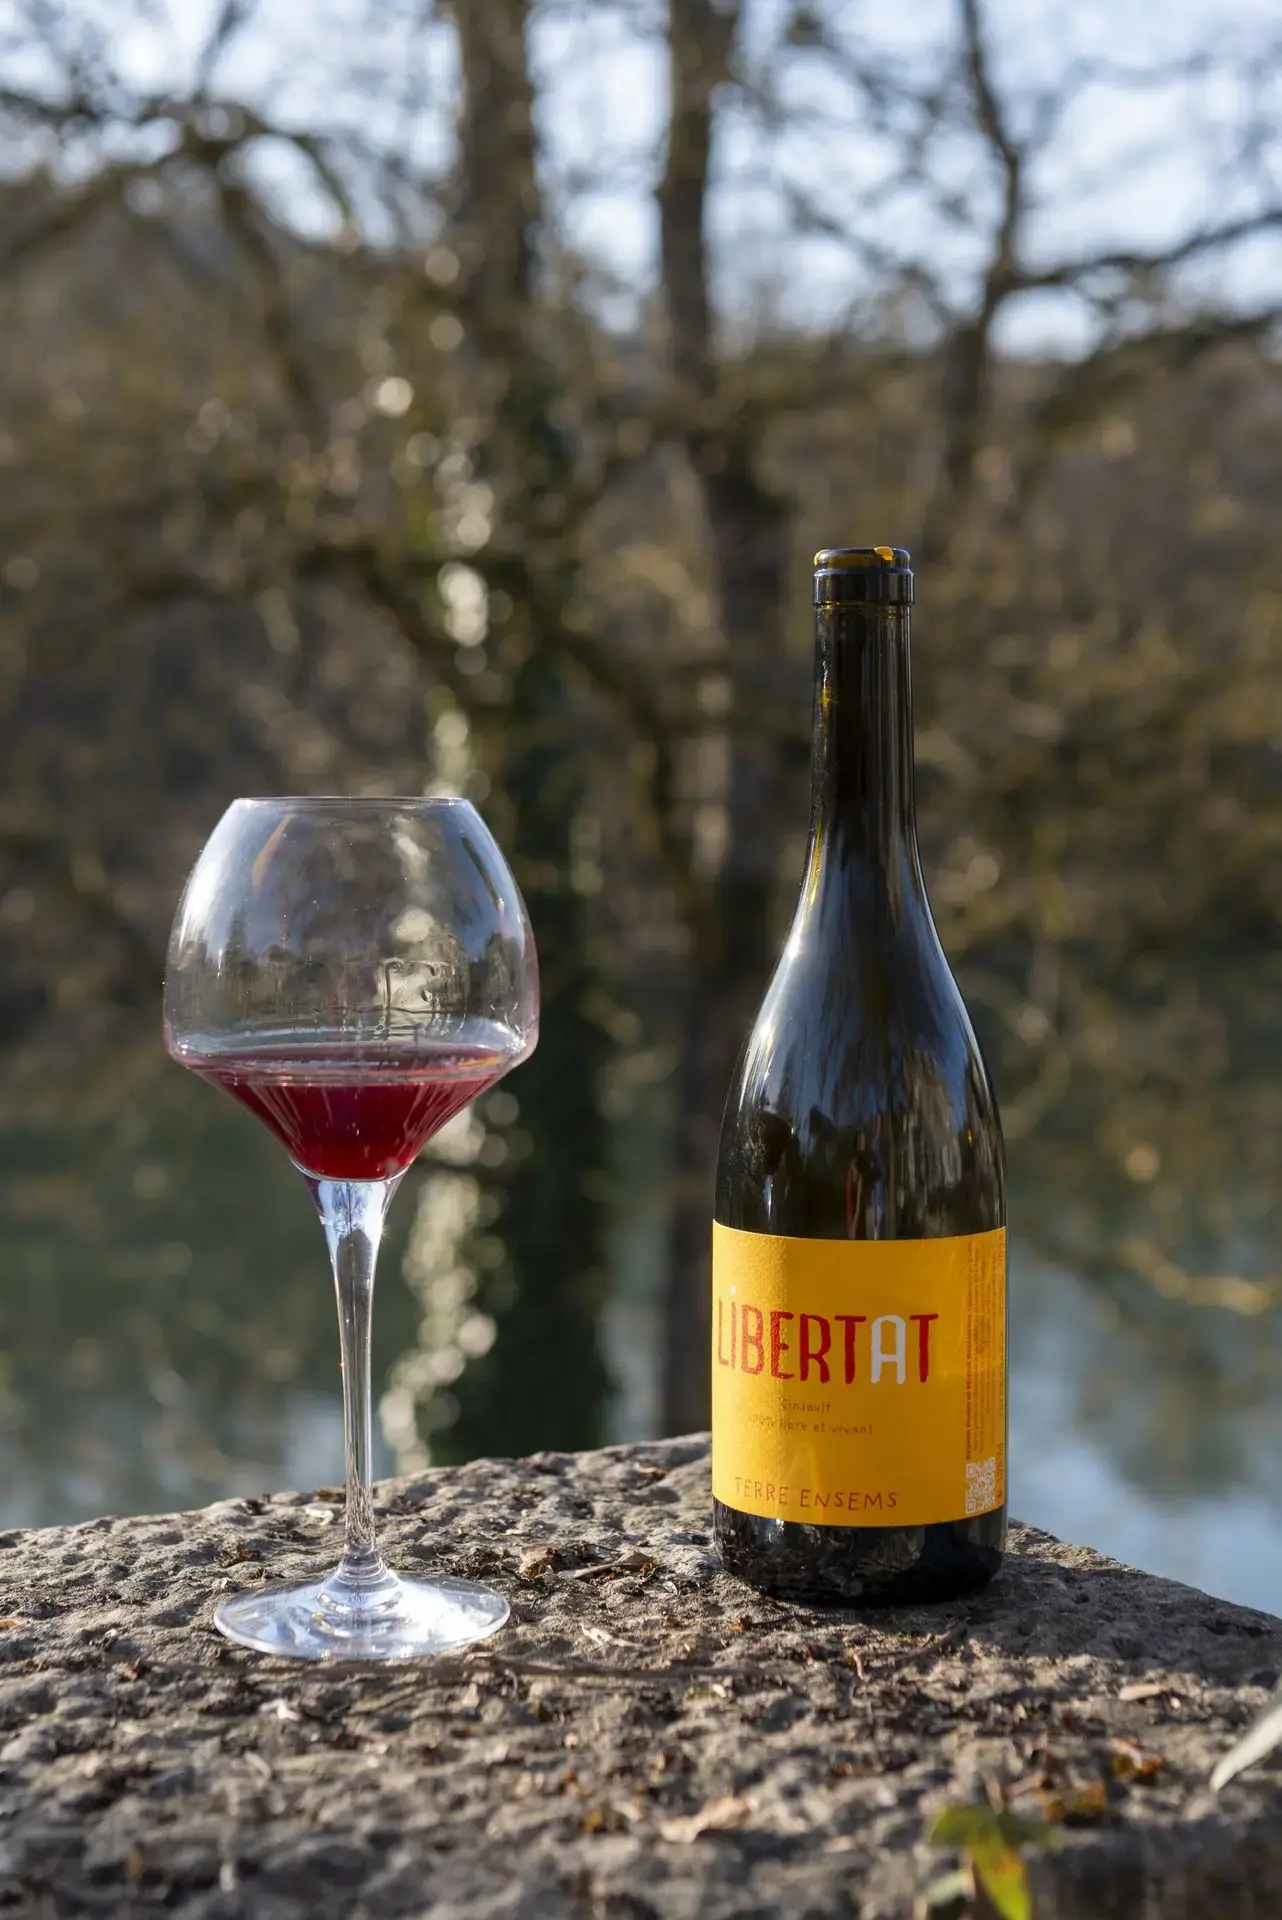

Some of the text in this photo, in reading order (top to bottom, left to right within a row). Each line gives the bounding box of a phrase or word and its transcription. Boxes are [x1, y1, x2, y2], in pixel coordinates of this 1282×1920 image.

[779, 1417, 808, 1432] libre
[813, 1421, 826, 1432] et
[831, 1422, 874, 1435] vivant
[734, 1477, 900, 1511] TERRE ENSEMS
